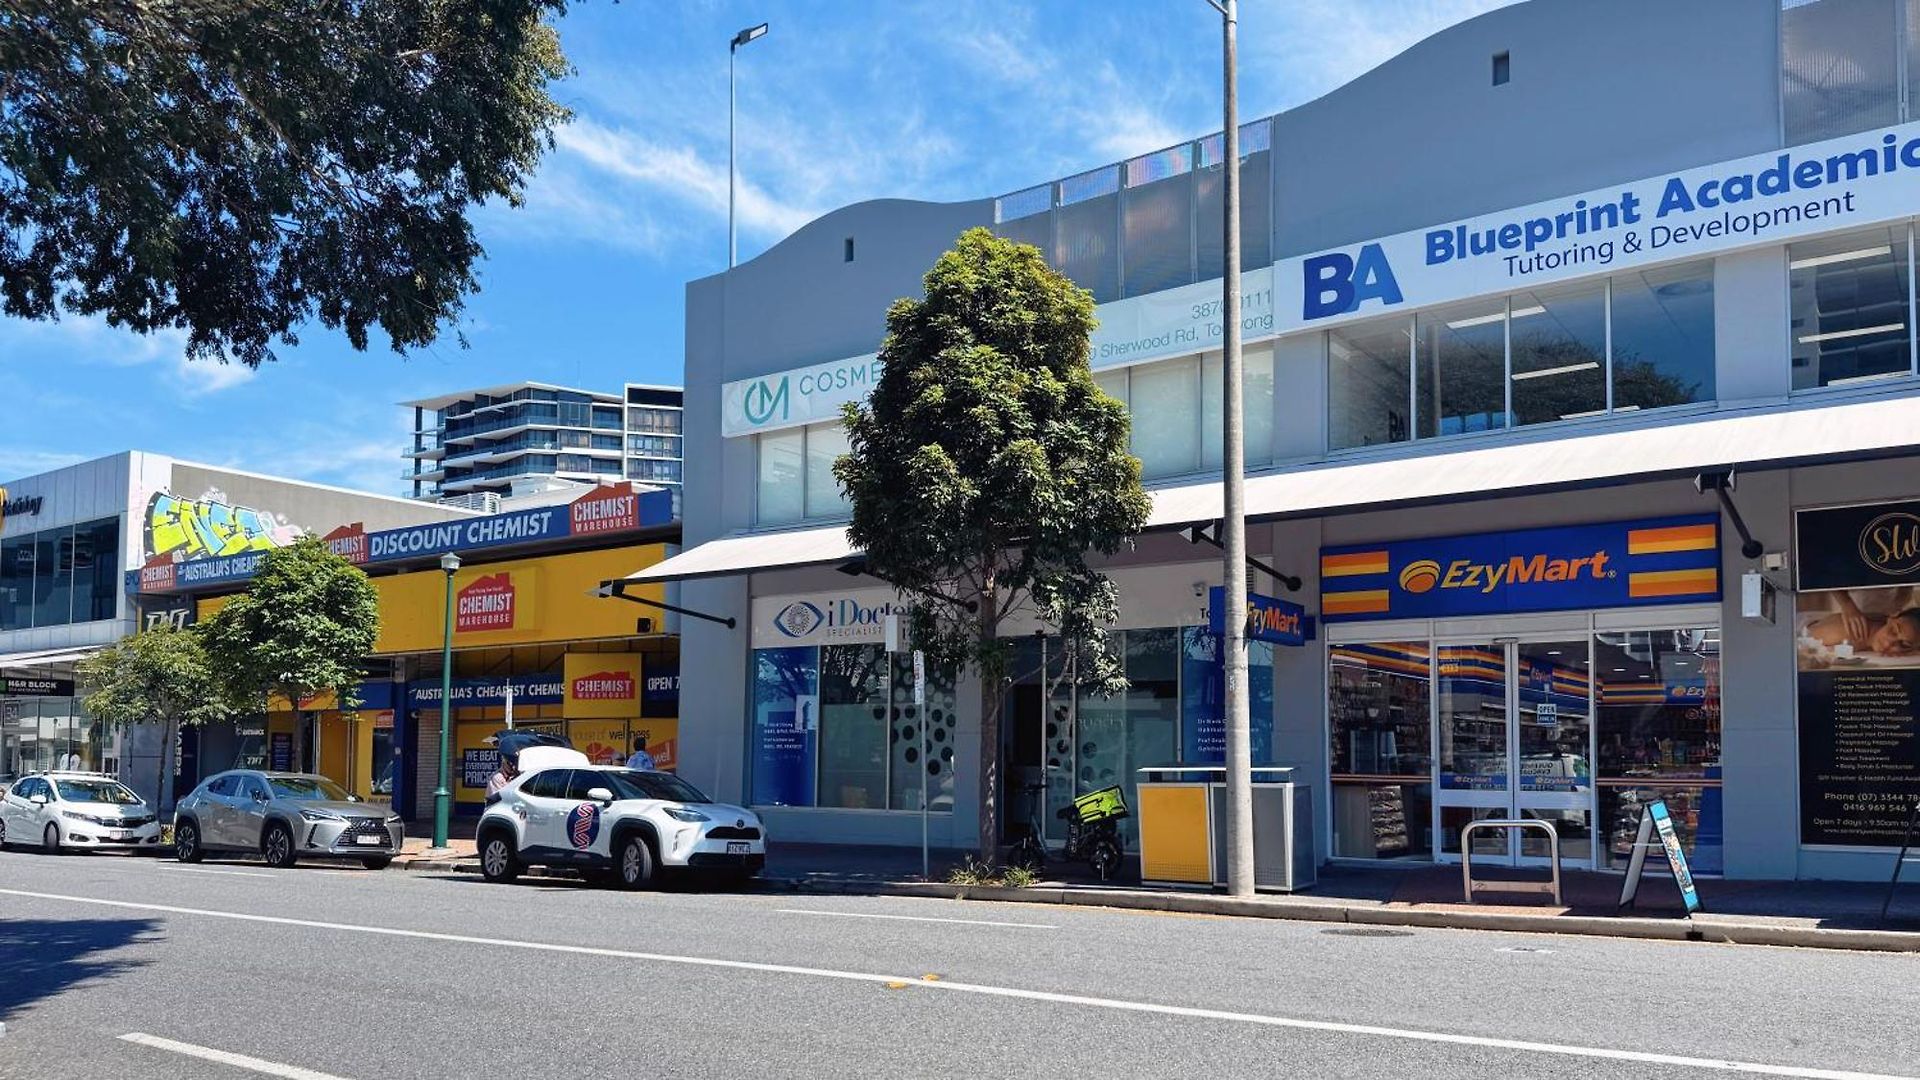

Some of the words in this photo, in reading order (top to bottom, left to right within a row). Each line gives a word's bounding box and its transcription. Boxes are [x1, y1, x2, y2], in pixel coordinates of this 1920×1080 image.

[1425, 192, 1641, 266] Blueprint
[1655, 134, 1920, 218] Academic
[1504, 240, 1614, 278] Tutoring
[1623, 232, 1641, 254] &
[1651, 190, 1855, 250] Development
[1303, 243, 1404, 321] BA
[1240, 289, 1271, 310] 111
[1101, 332, 1170, 359] Sherwood
[1175, 327, 1199, 343] Rd,
[574, 496, 634, 522] CHEMIST
[371, 525, 462, 556] DISCOUNT
[467, 511, 552, 543] CHEMIST
[575, 516, 634, 533] WAREHOUSE
[142, 565, 174, 582] CHEMIST
[184, 558, 230, 581] AUSTRALIA'S
[1441, 550, 1609, 593] EzyMart
[460, 593, 513, 615] CHEMIST
[459, 614, 510, 626] WAREHOUSE
[28, 681, 57, 689] BLOCK
[415, 686, 473, 701] AUSTRLIA'S
[576, 680, 632, 693] CHEMIST
[648, 677, 673, 691] OPEN
[465, 750, 480, 761] WE
[480, 749, 499, 761] BEAT
[1824, 793, 1855, 801] Phone
[1858, 793, 1878, 802] (07)
[1907, 794, 1920, 802] 78
